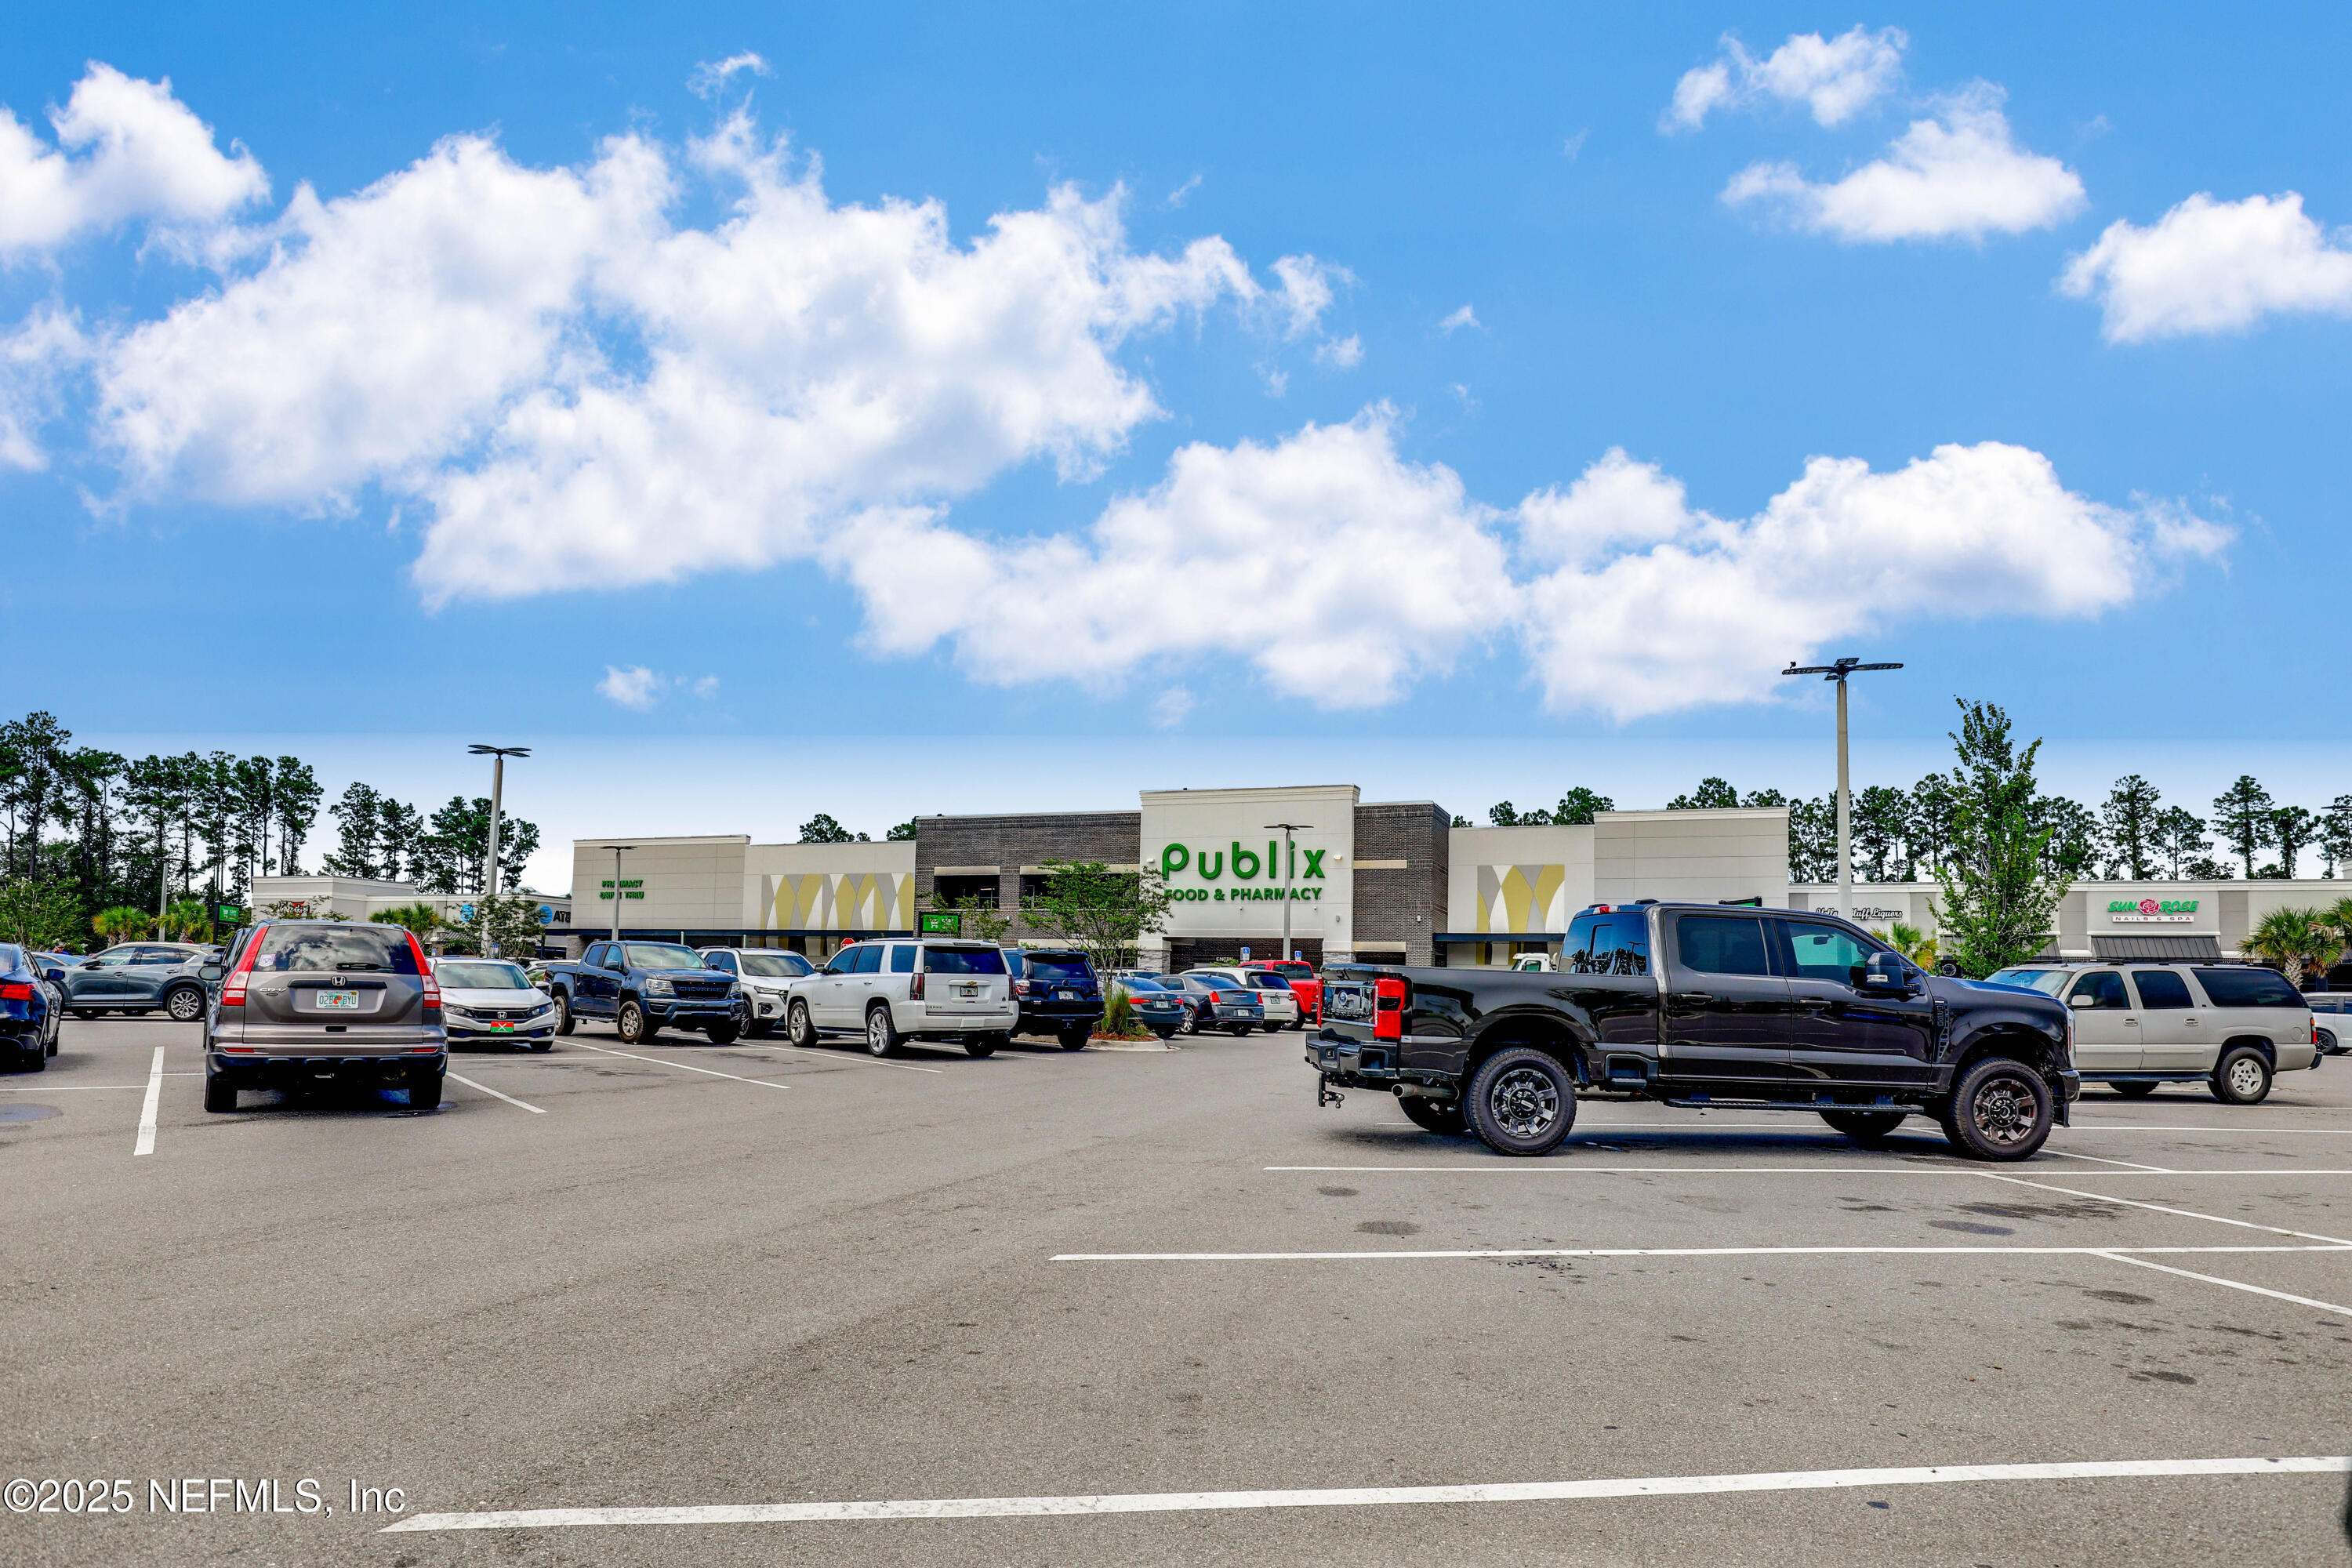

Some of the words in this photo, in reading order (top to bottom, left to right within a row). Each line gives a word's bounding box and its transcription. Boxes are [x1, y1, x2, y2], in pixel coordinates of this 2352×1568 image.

[1162, 840, 1325, 880] Publix
[624, 891, 644, 899] THRU
[1164, 888, 1208, 901] FOOD
[1214, 888, 1225, 900] &
[1231, 887, 1322, 901] PHARMACY
[1852, 907, 1871, 920] luff
[1871, 907, 1903, 920] Liquors
[2107, 901, 2137, 911] SUN
[2160, 901, 2199, 915] ROSE
[553, 910, 571, 923] AT&
